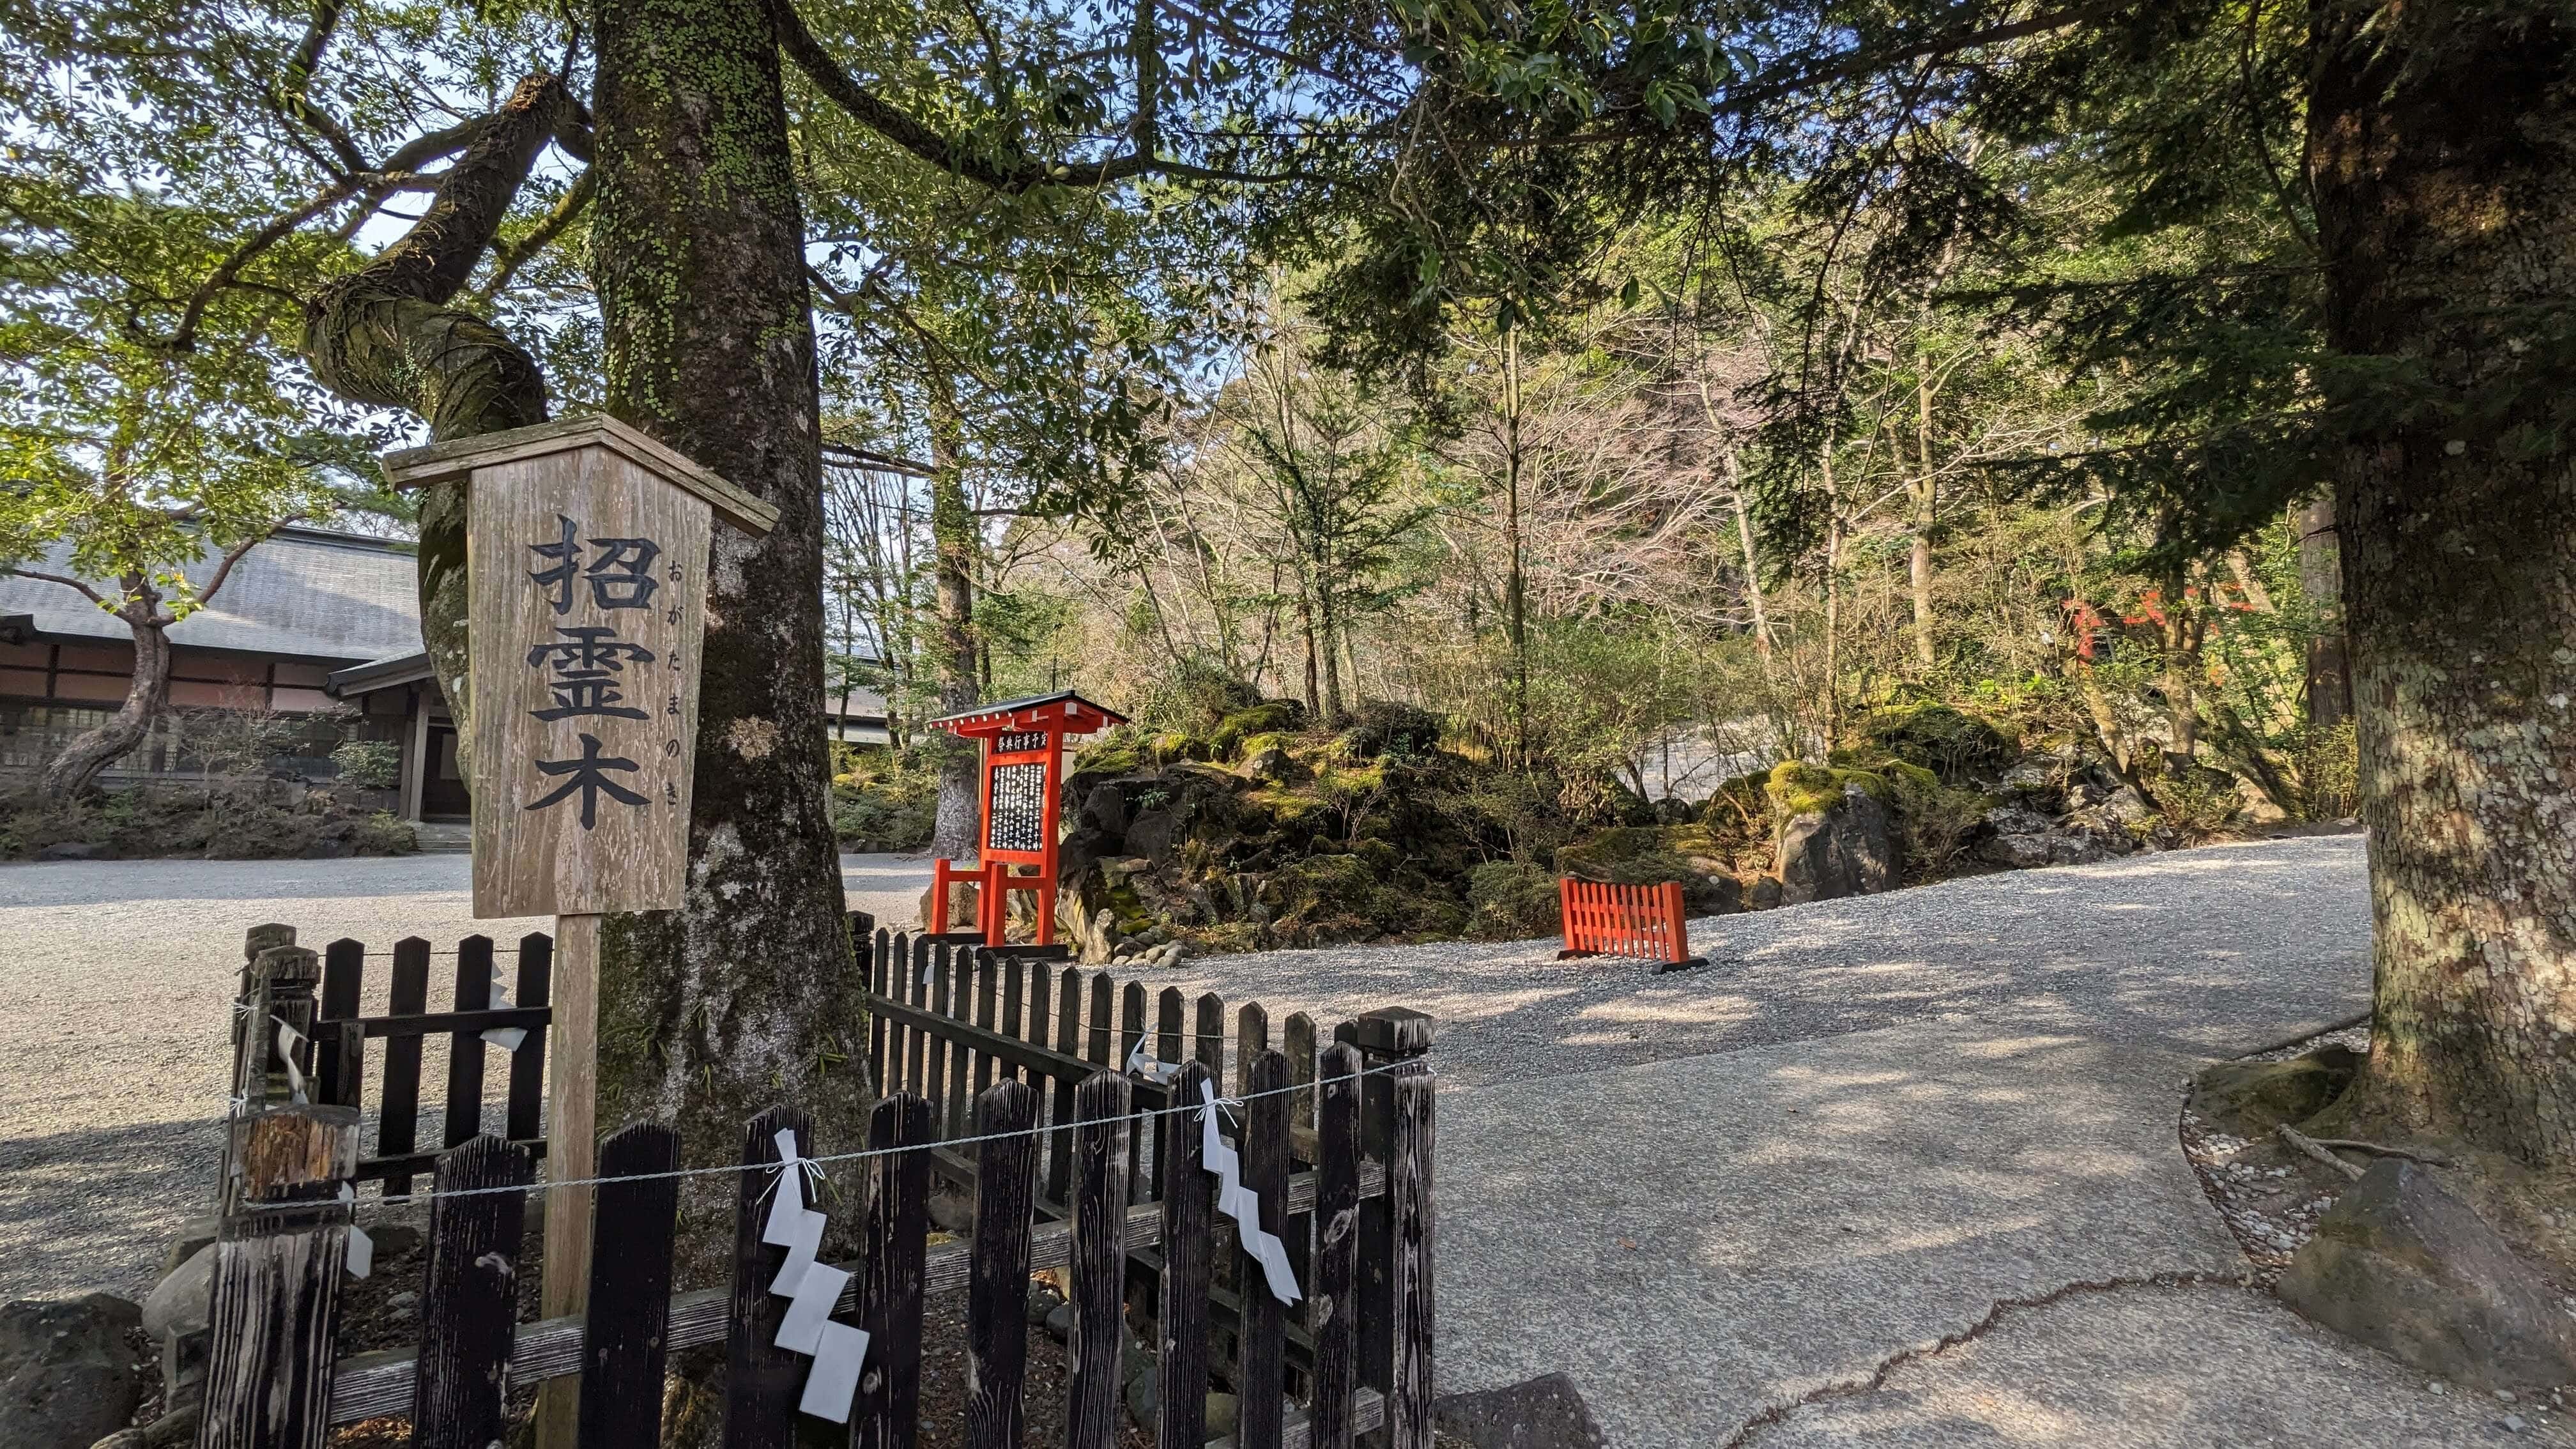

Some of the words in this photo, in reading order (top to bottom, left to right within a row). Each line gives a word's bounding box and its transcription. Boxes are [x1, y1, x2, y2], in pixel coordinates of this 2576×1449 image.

[523, 513, 662, 831] 招霊木
[666, 560, 684, 806] おがたまのき
[998, 730, 1048, 753] 祭典行事予定
